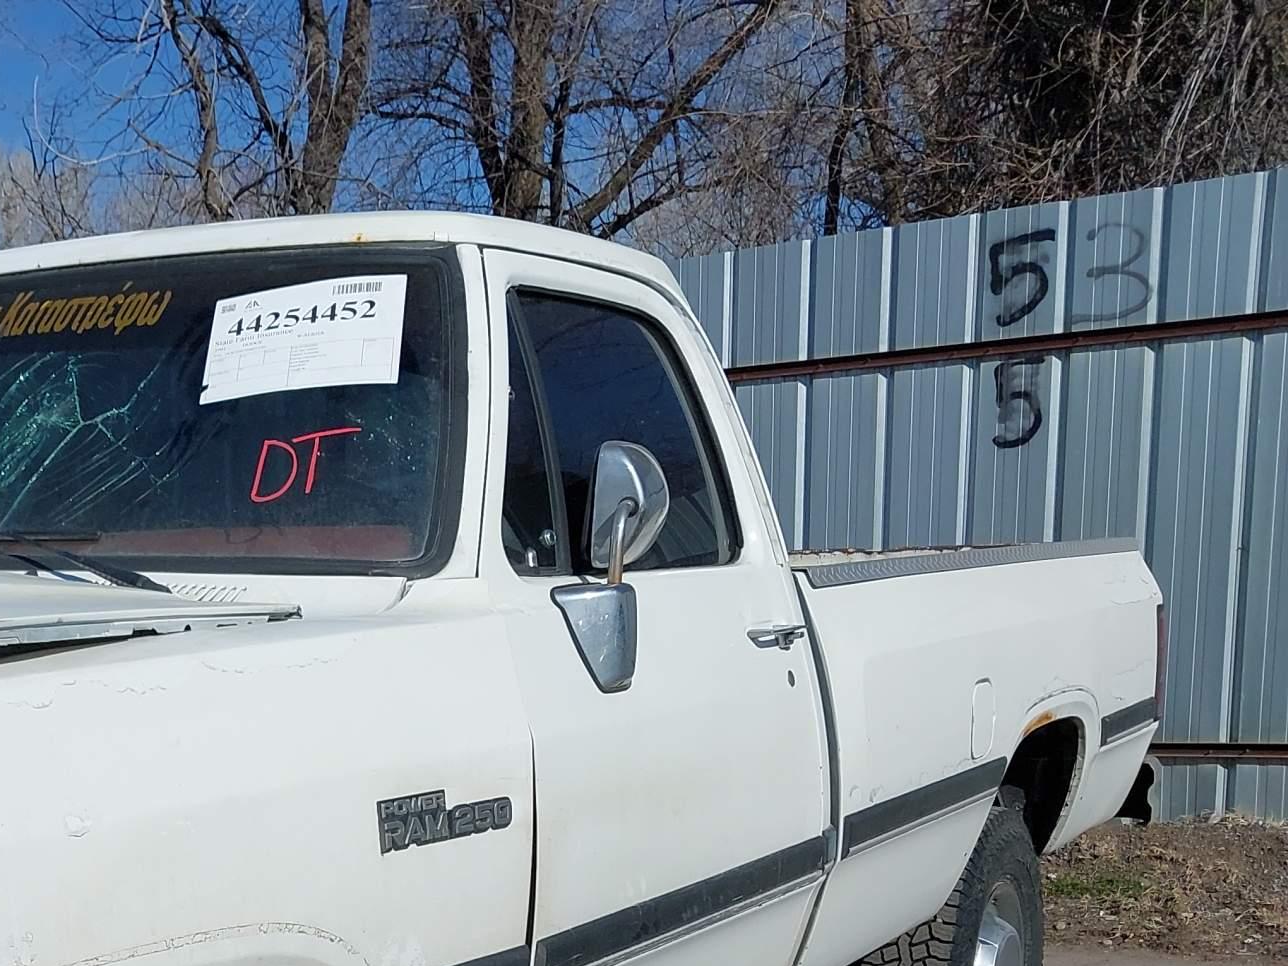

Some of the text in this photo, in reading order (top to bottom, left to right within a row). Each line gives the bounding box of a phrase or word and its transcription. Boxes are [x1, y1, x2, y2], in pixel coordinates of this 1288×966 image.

[227, 299, 377, 337] 44254452
[992, 356, 1043, 449] 5
[250, 427, 362, 502] DT
[380, 793, 445, 818] POWER
[383, 800, 511, 849] RAM 250
